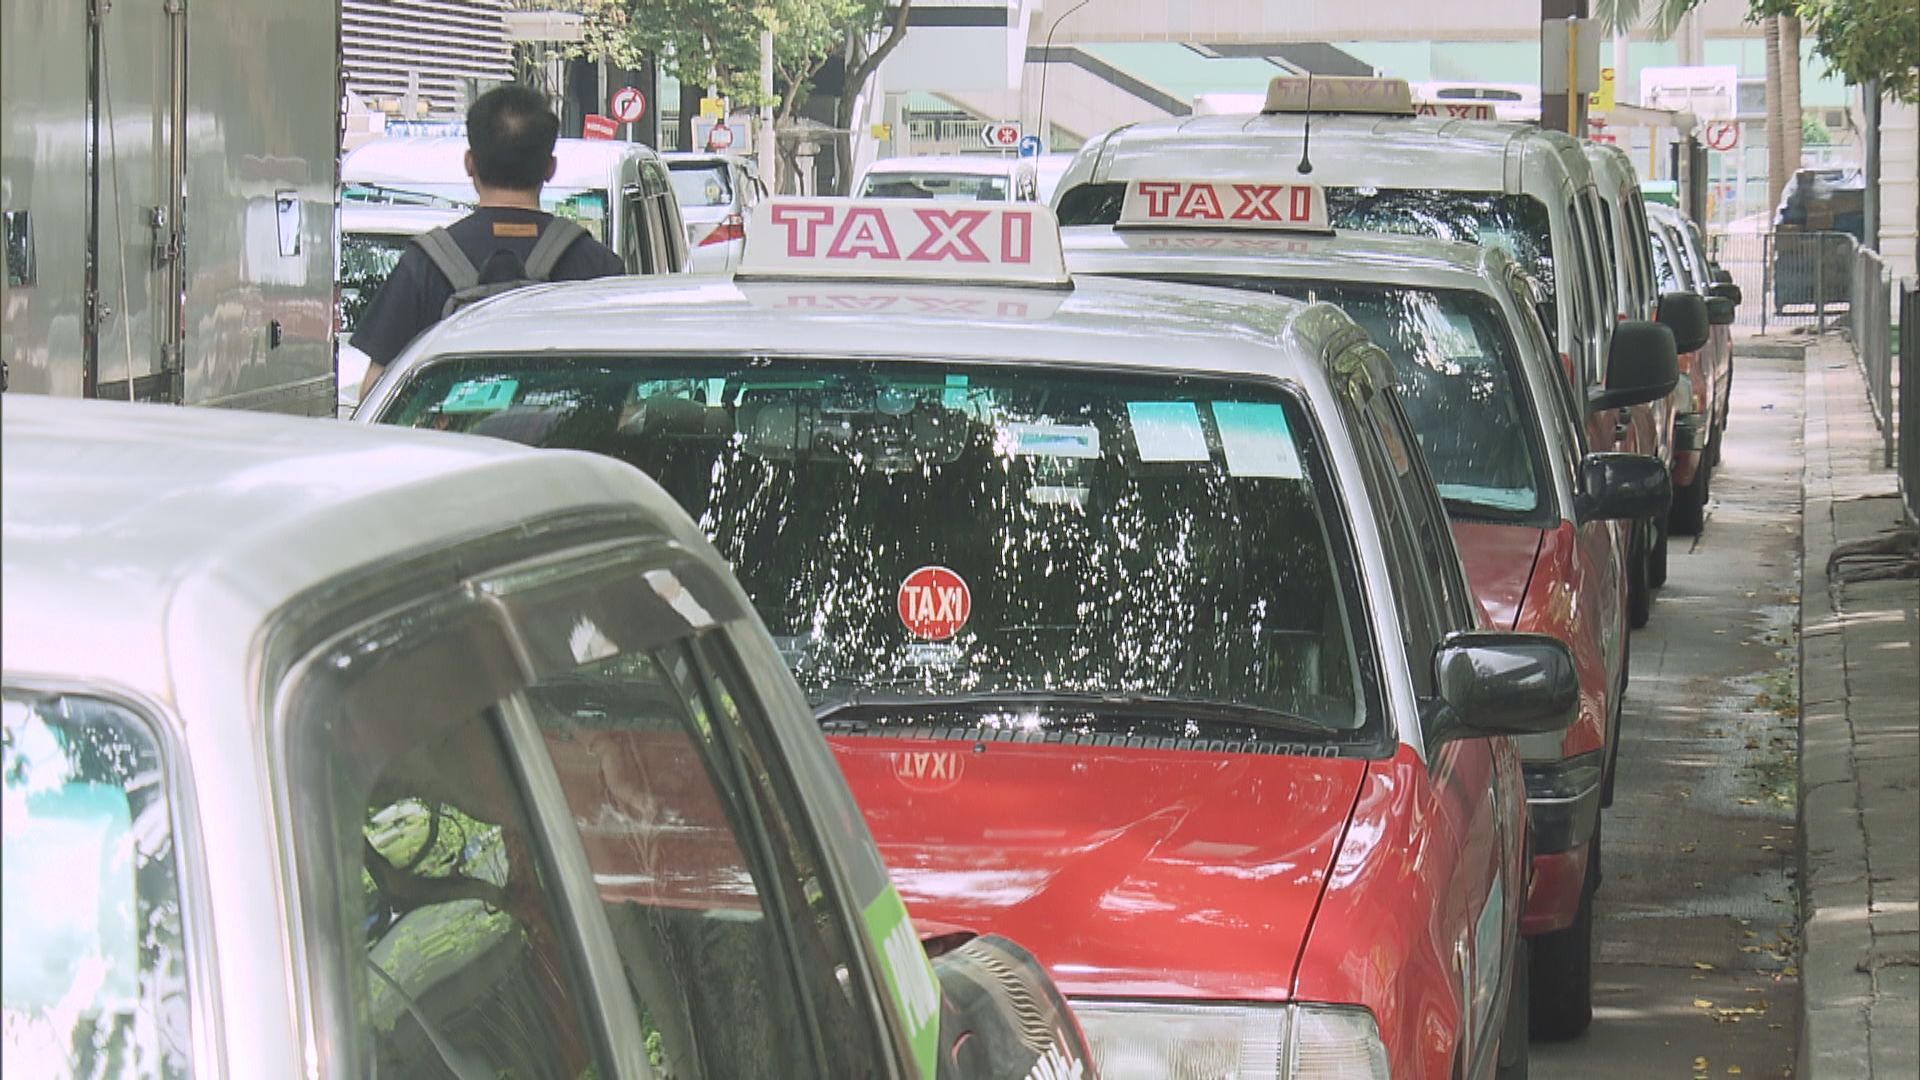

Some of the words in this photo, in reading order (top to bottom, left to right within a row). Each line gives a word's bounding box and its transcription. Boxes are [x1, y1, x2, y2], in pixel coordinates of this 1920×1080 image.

[1139, 182, 1311, 222] TAXI
[771, 204, 1032, 264] TAXI
[904, 586, 963, 621] TAXI
